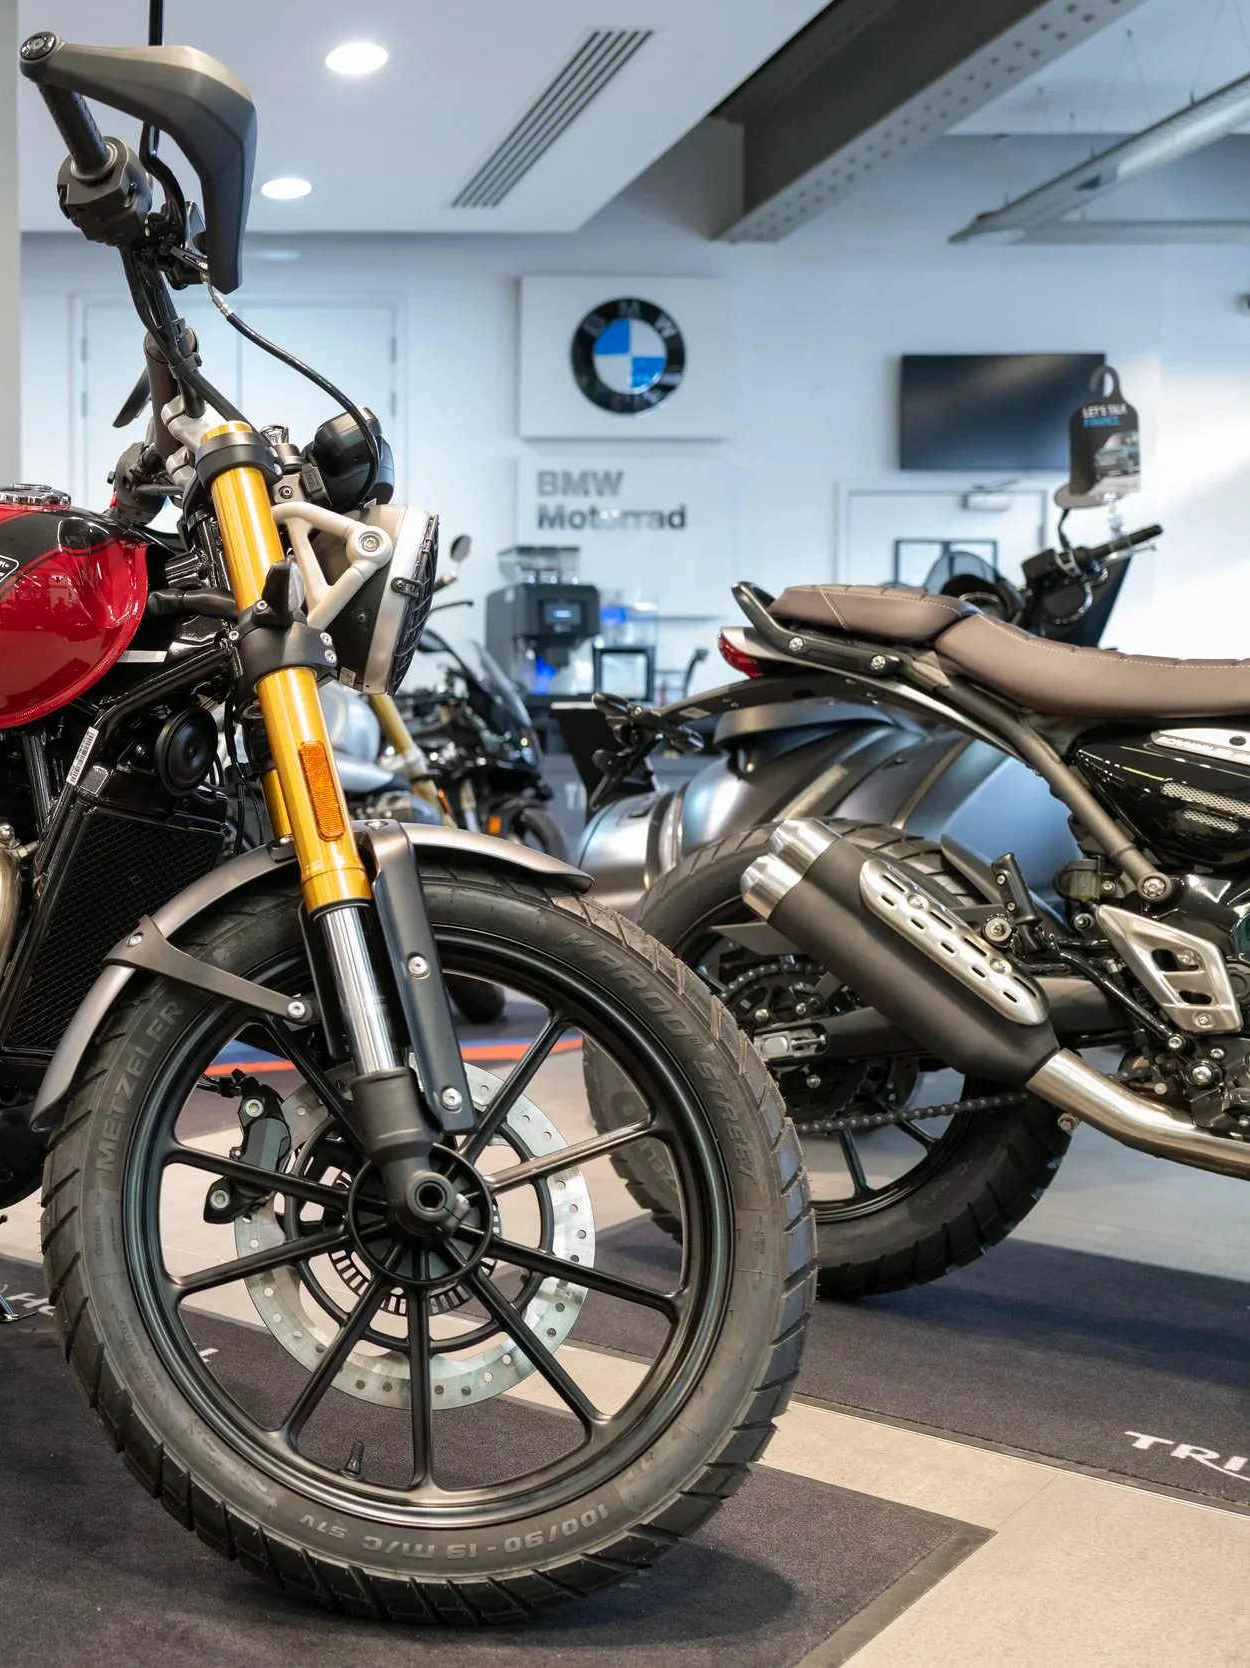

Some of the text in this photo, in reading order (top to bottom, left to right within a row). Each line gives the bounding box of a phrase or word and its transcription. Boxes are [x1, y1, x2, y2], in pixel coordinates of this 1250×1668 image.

[537, 470, 624, 497] BMW
[538, 504, 687, 531] Motorrad
[95, 1001, 184, 1172] METZELER
[557, 933, 758, 1186] KAROO STREET
